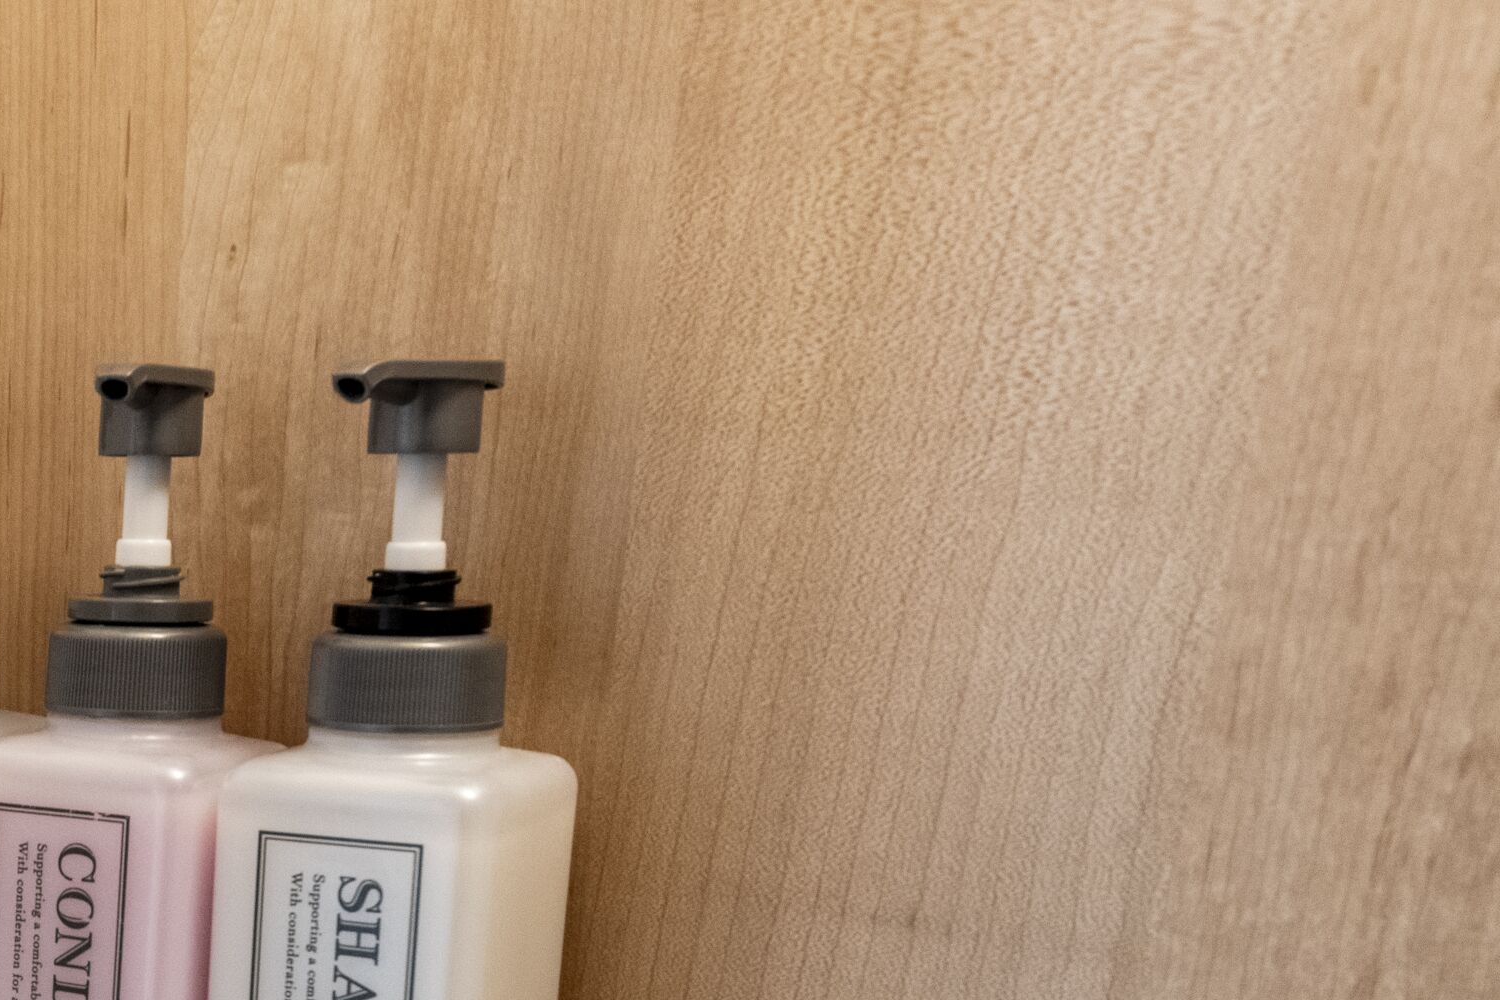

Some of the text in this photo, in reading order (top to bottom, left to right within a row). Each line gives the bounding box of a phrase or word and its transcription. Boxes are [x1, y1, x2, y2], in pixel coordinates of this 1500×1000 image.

[15, 840, 29, 875] With
[29, 841, 48, 919] Supporting
[288, 871, 304, 907] With
[304, 872, 326, 954] Supporting
[11, 877, 27, 970] consideration
[10, 972, 24, 994] for
